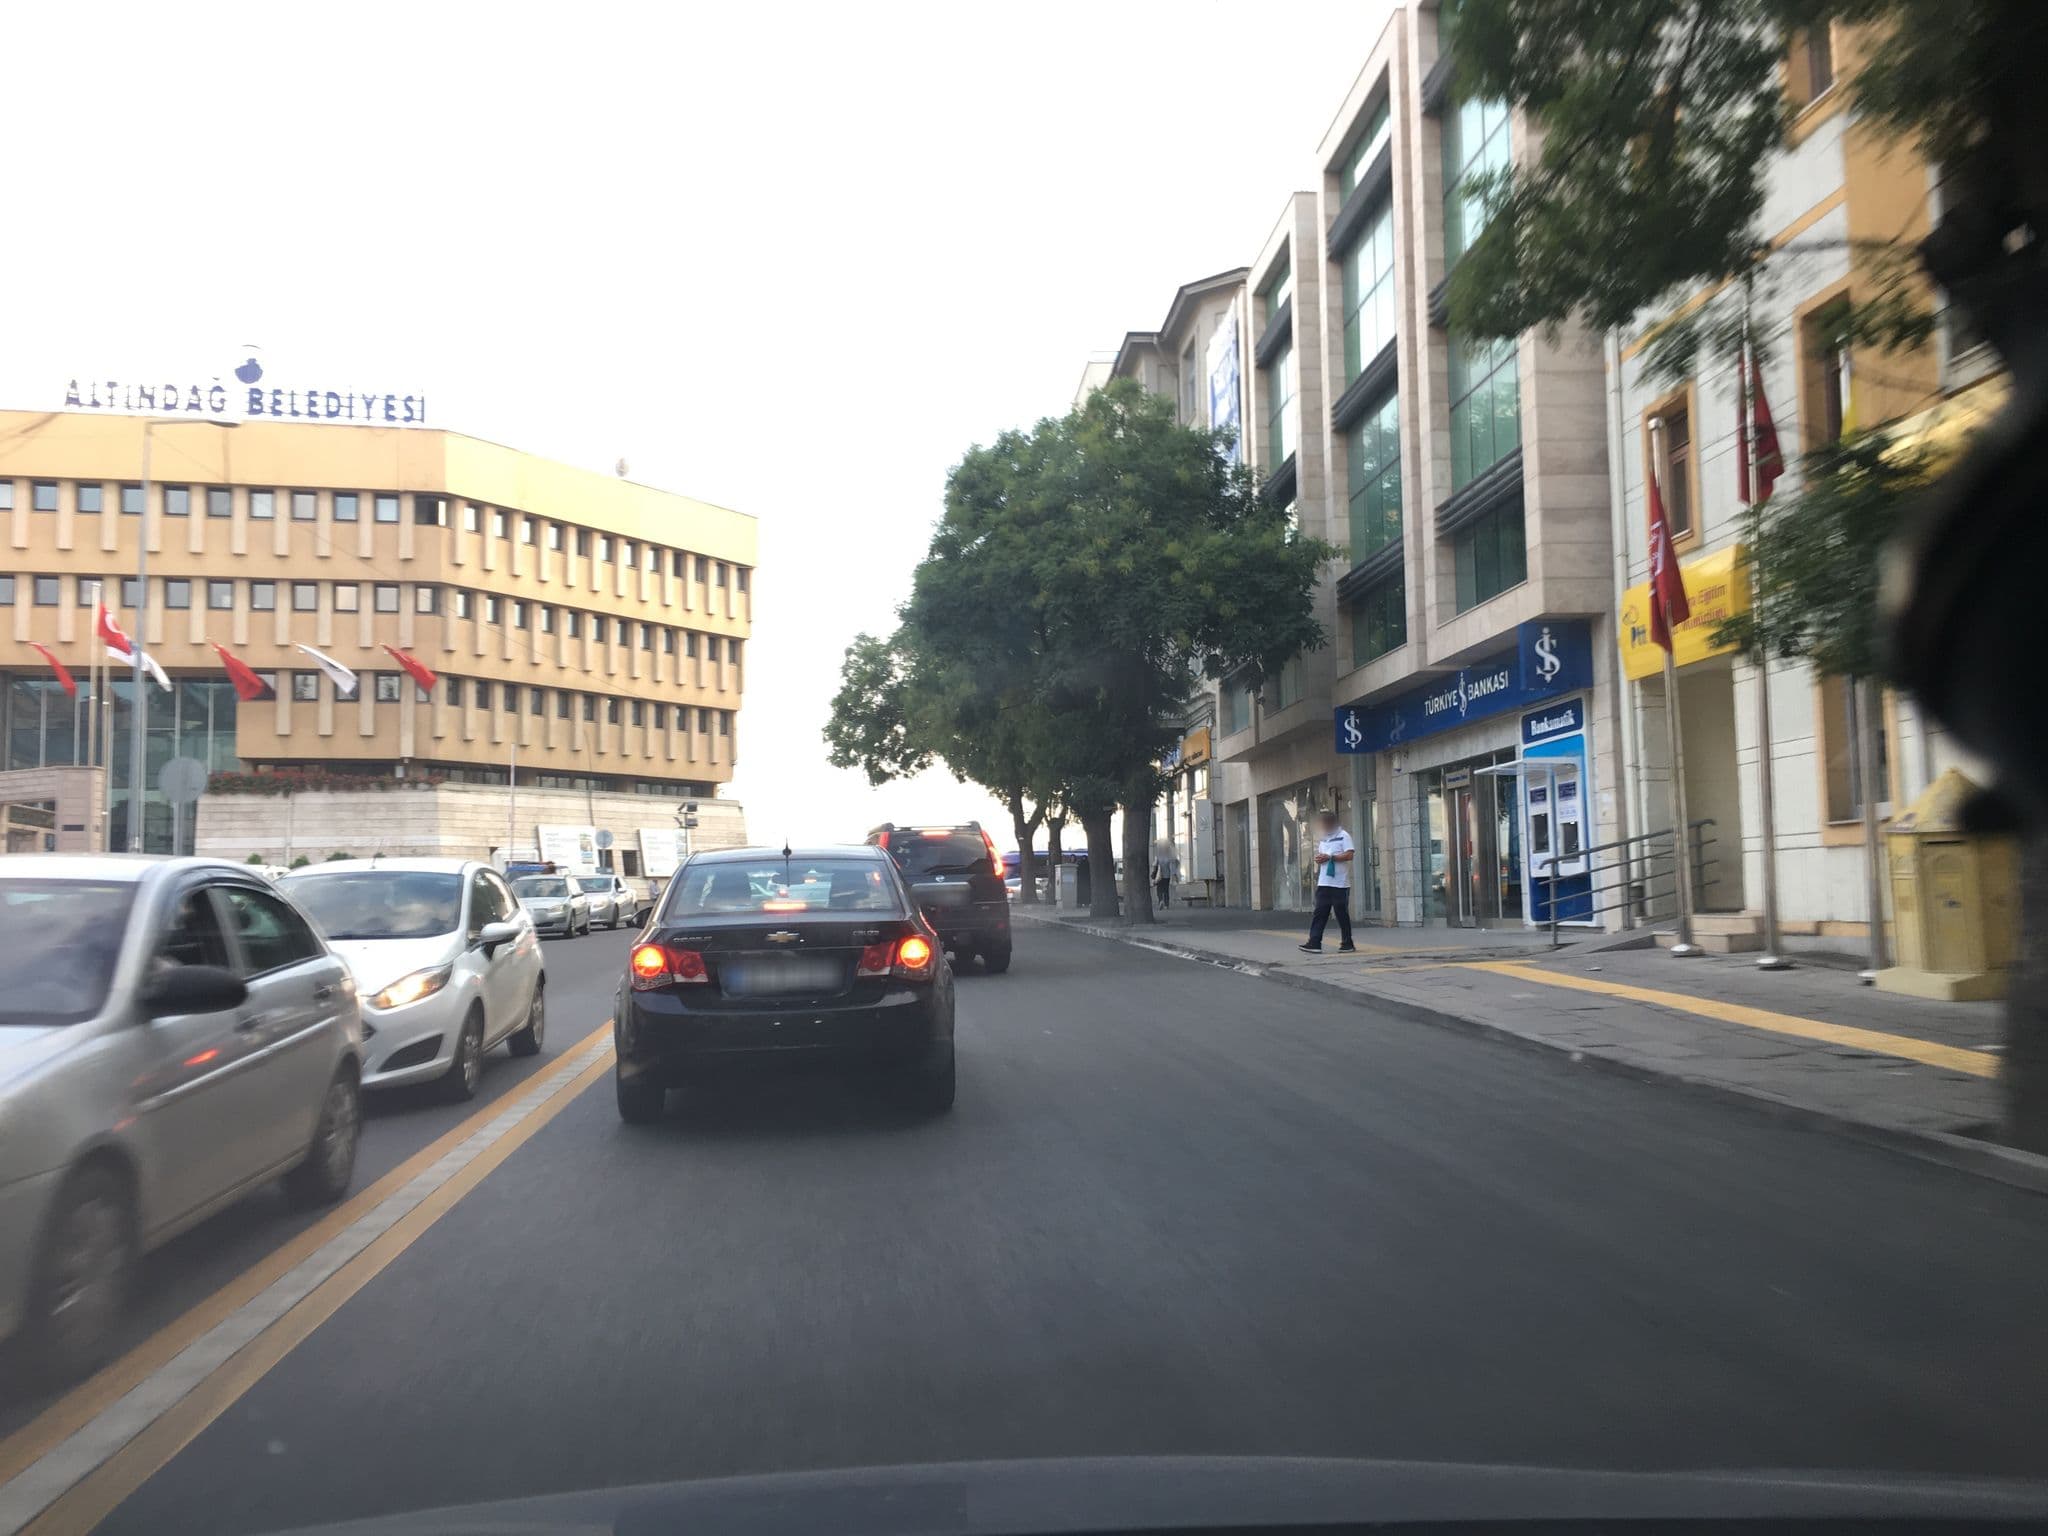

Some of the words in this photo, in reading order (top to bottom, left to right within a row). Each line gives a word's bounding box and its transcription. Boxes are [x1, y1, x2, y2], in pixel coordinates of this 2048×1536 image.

[64, 376, 227, 413] ALTINDAĞ
[247, 385, 425, 423] BELEDİYESİ
[1424, 688, 1459, 717] TÜRKİYE
[1467, 670, 1509, 701] BANKASI
